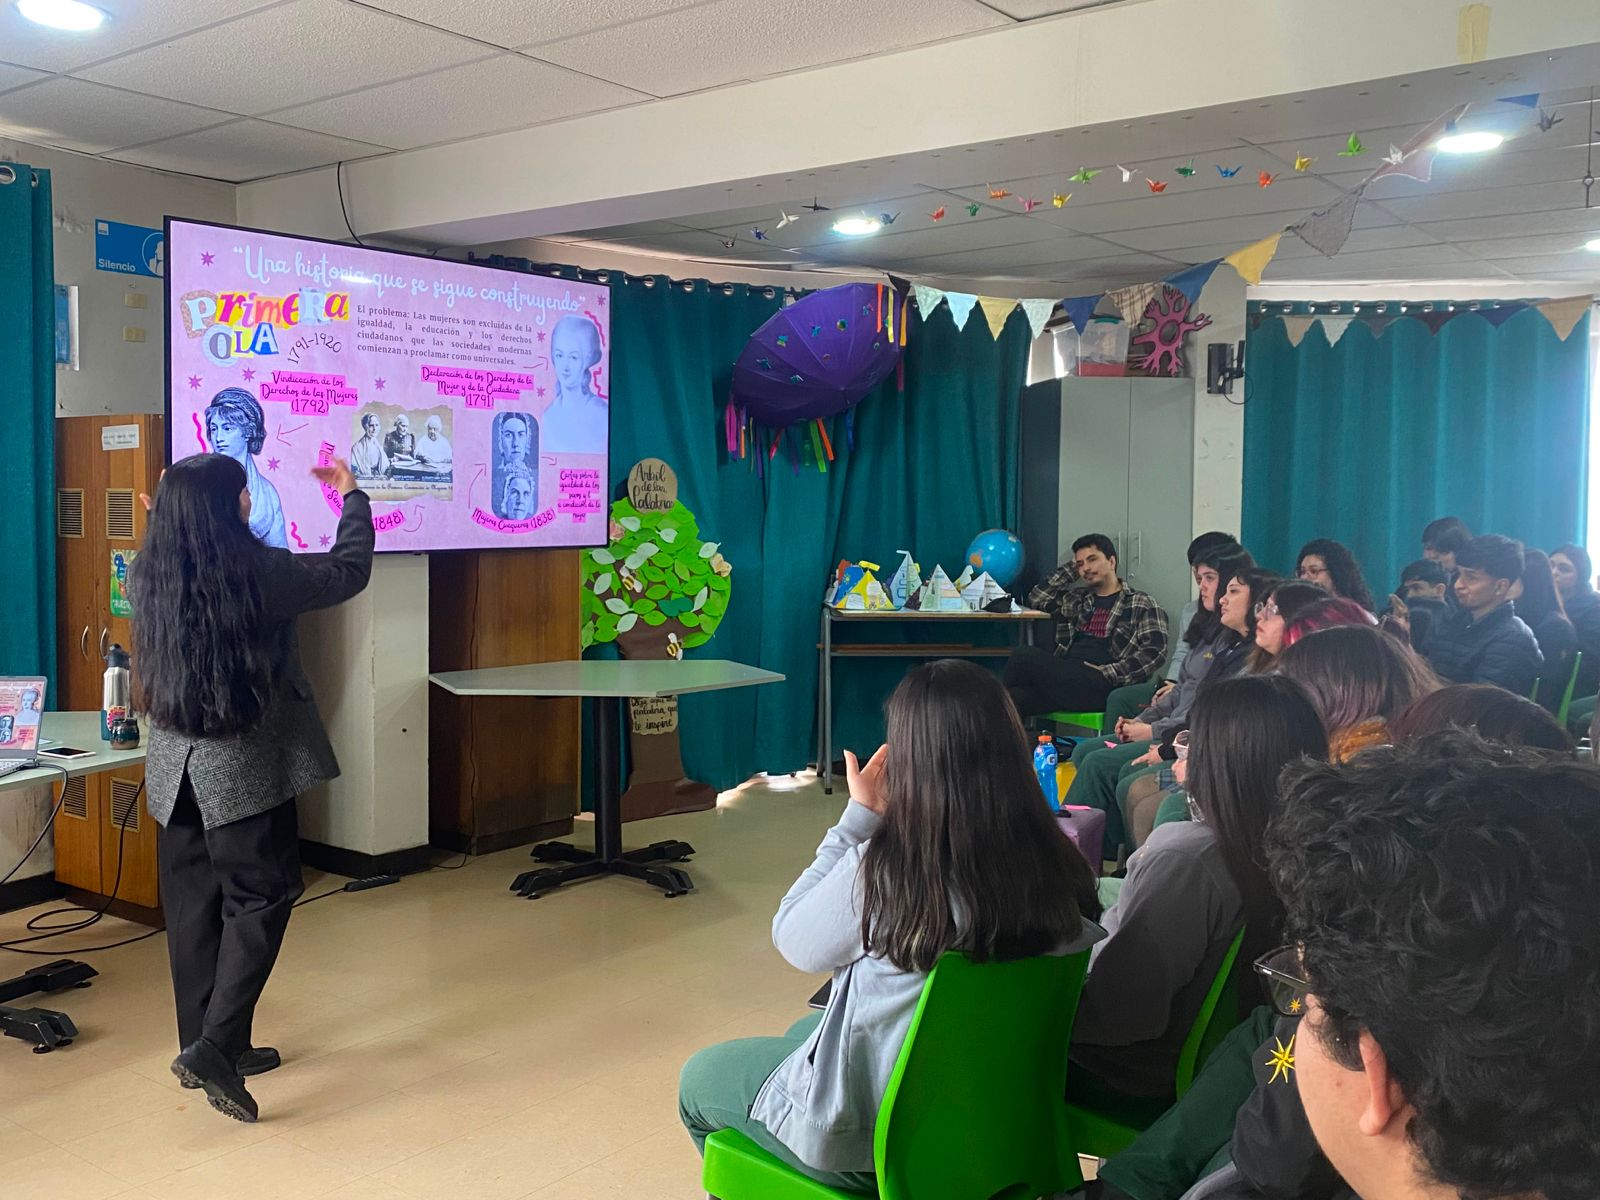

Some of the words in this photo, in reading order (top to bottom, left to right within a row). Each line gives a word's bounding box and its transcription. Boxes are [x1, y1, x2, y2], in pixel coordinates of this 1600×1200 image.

[98, 258, 136, 272] Silencio
[295, 251, 367, 288] historia
[373, 271, 406, 298] que
[411, 277, 429, 296] se
[433, 279, 477, 308] sigue
[357, 304, 366, 313] El
[369, 306, 410, 318] problema:
[413, 311, 427, 320] Las
[429, 314, 460, 324] mujeres
[462, 318, 476, 326] son
[514, 323, 524, 331] de
[525, 324, 532, 333] la
[208, 322, 280, 360] OLA
[357, 316, 396, 331] igualdad,
[405, 322, 413, 331] la
[421, 324, 460, 336] educación
[468, 331, 474, 339] y
[481, 331, 493, 339] los
[500, 333, 532, 344] derechos
[287, 332, 343, 365] 1791-1920
[357, 330, 404, 342] ciudadanos
[411, 337, 426, 346] que
[432, 337, 444, 346] las
[451, 341, 491, 351] sociedades
[497, 346, 532, 355] modernas
[357, 344, 402, 355] comienzan
[410, 349, 450, 359] proclamar
[451, 353, 472, 361] como
[271, 370, 320, 385] Vindicación
[321, 376, 331, 386] de
[332, 377, 345, 388] los
[437, 380, 460, 396] Mujer
[461, 384, 467, 398] y
[467, 382, 476, 391] de
[476, 383, 484, 392] la
[464, 370, 474, 380] de
[474, 371, 484, 382] los
[486, 372, 515, 386] Derechos
[516, 376, 525, 384] de
[525, 376, 533, 385] la
[260, 383, 299, 400] Derechos
[301, 387, 311, 396] de
[312, 387, 325, 399] las
[326, 388, 359, 405] Mujeres
[465, 393, 494, 407] (1791)
[291, 398, 330, 414] (1792)
[471, 507, 497, 527] Mujeres
[530, 508, 556, 529] (1838)
